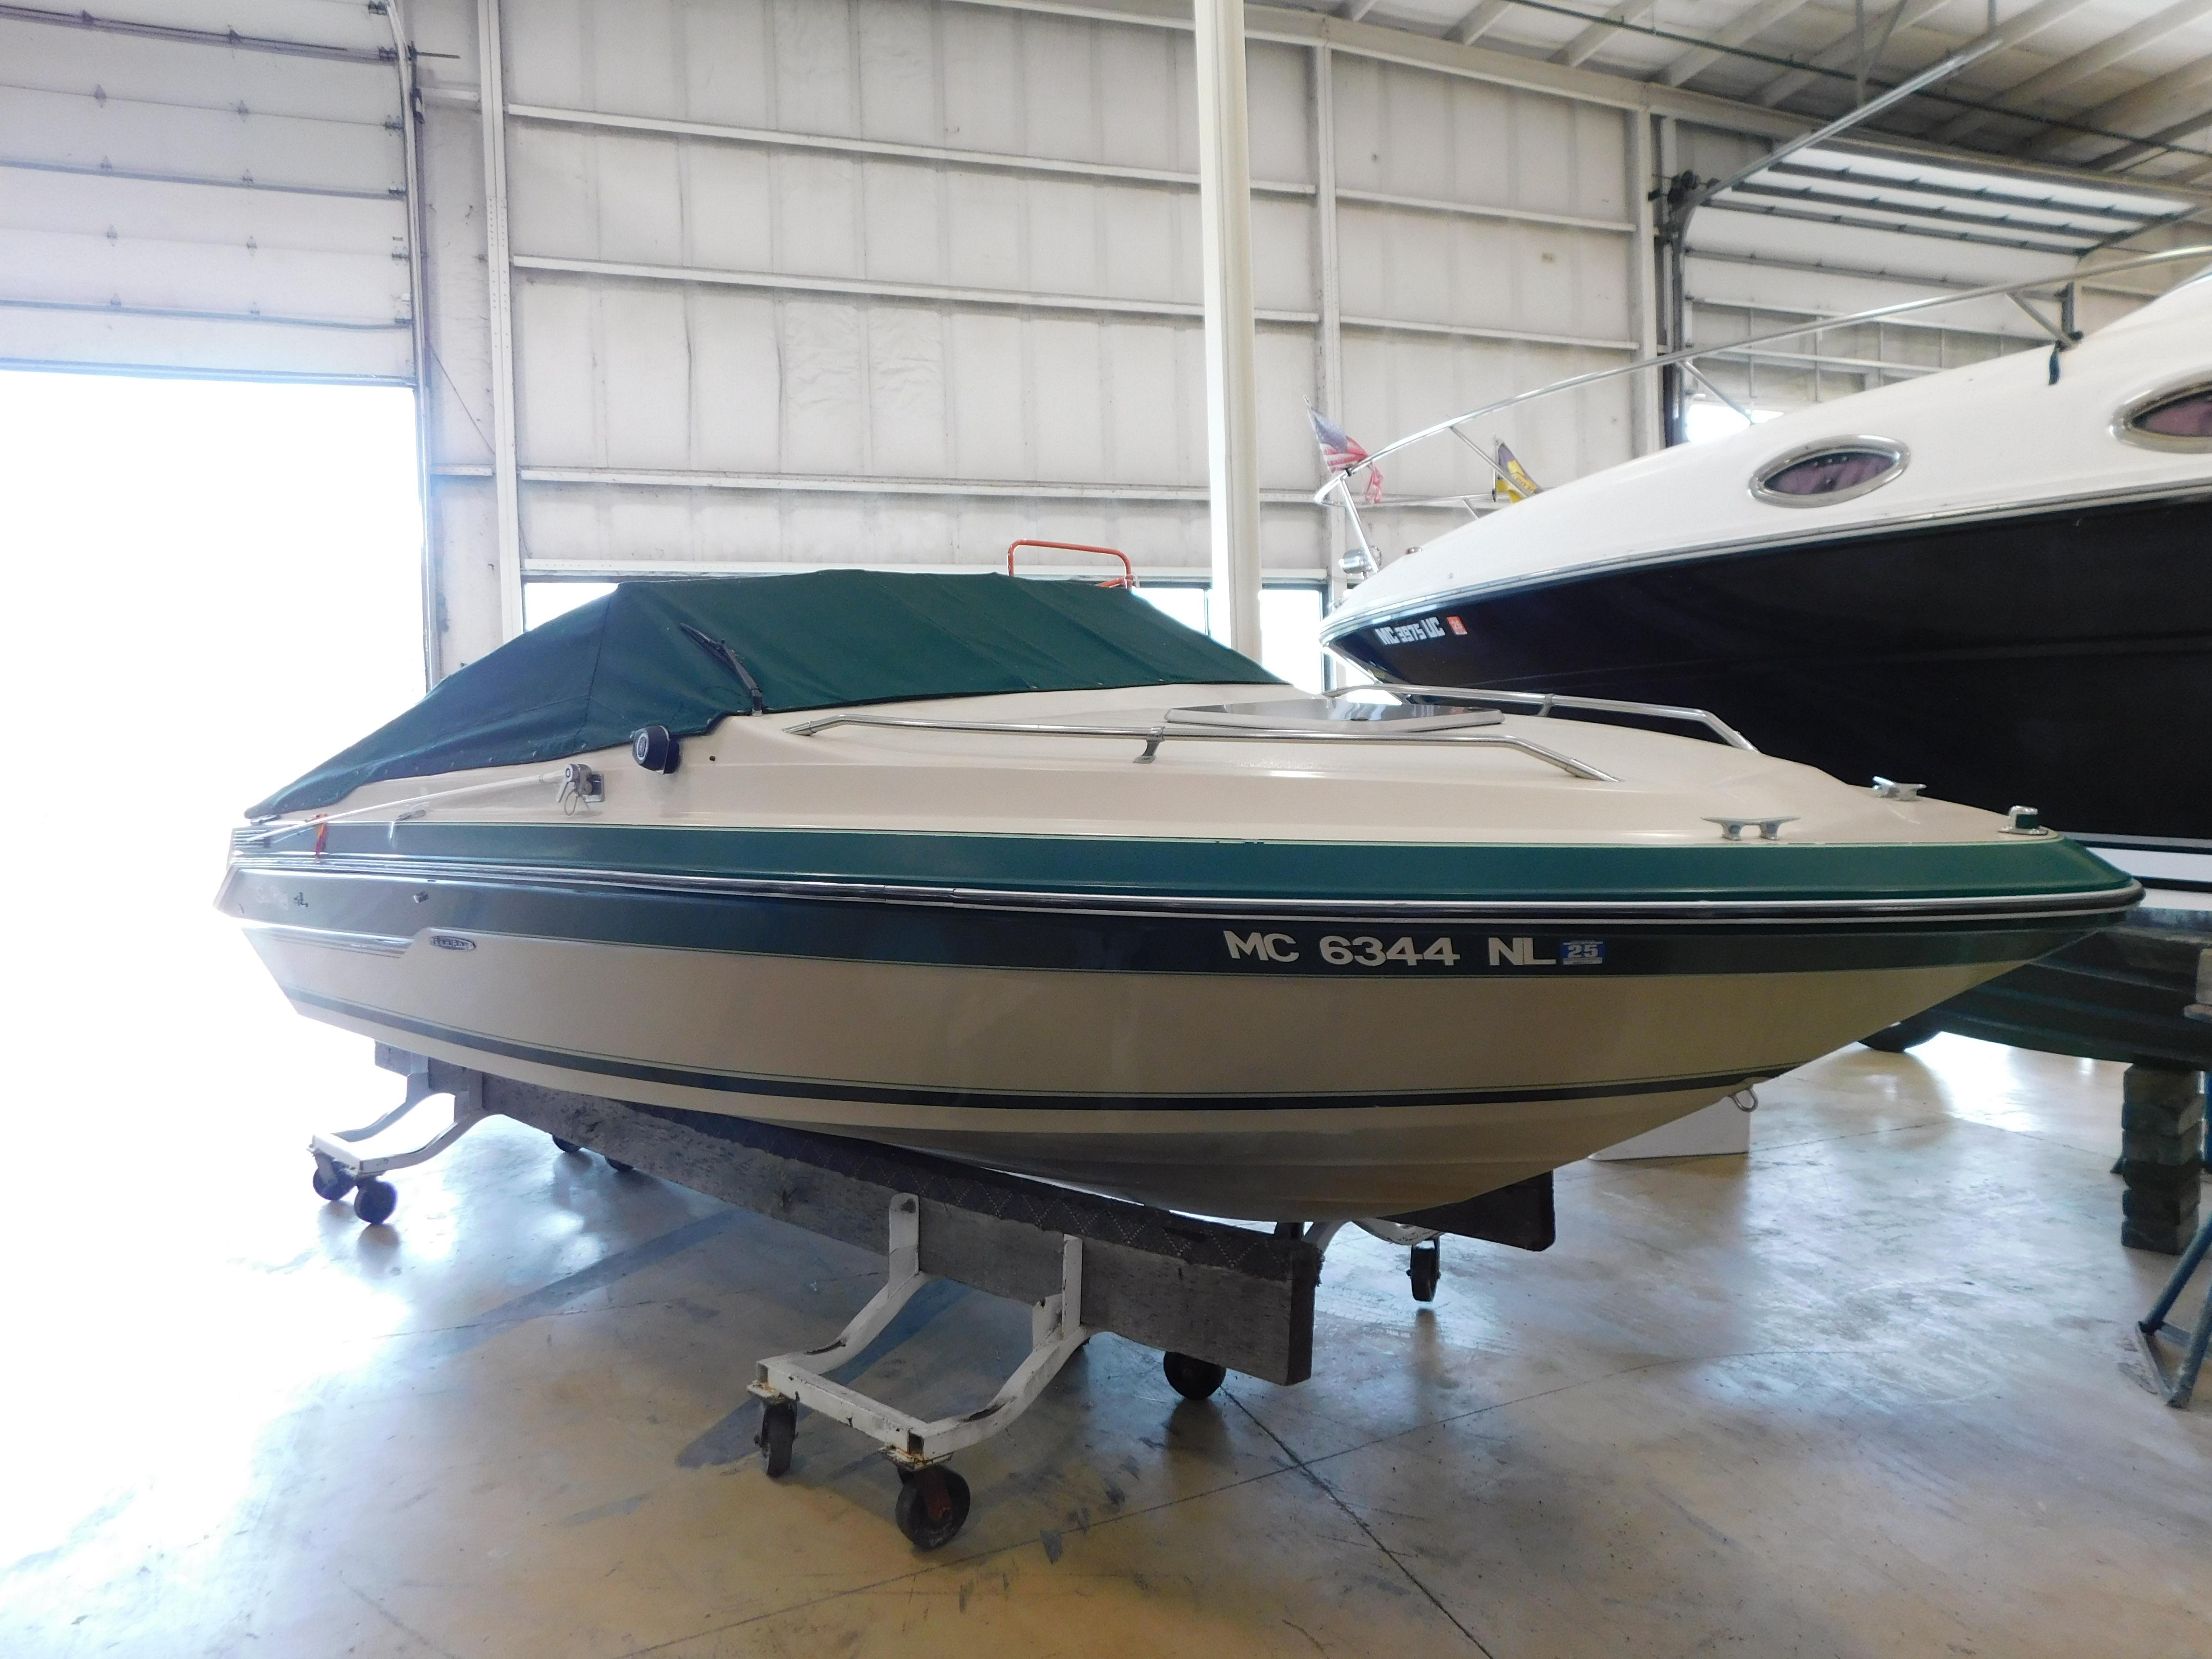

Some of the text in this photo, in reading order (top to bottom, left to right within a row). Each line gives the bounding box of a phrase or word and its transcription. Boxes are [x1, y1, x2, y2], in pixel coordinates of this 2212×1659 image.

[1375, 626, 1400, 645] MC
[1395, 624, 1427, 642] 3975
[1421, 617, 1446, 638] UC
[1223, 931, 1557, 966] MC 6344 NL
[1568, 944, 1598, 958] 25
